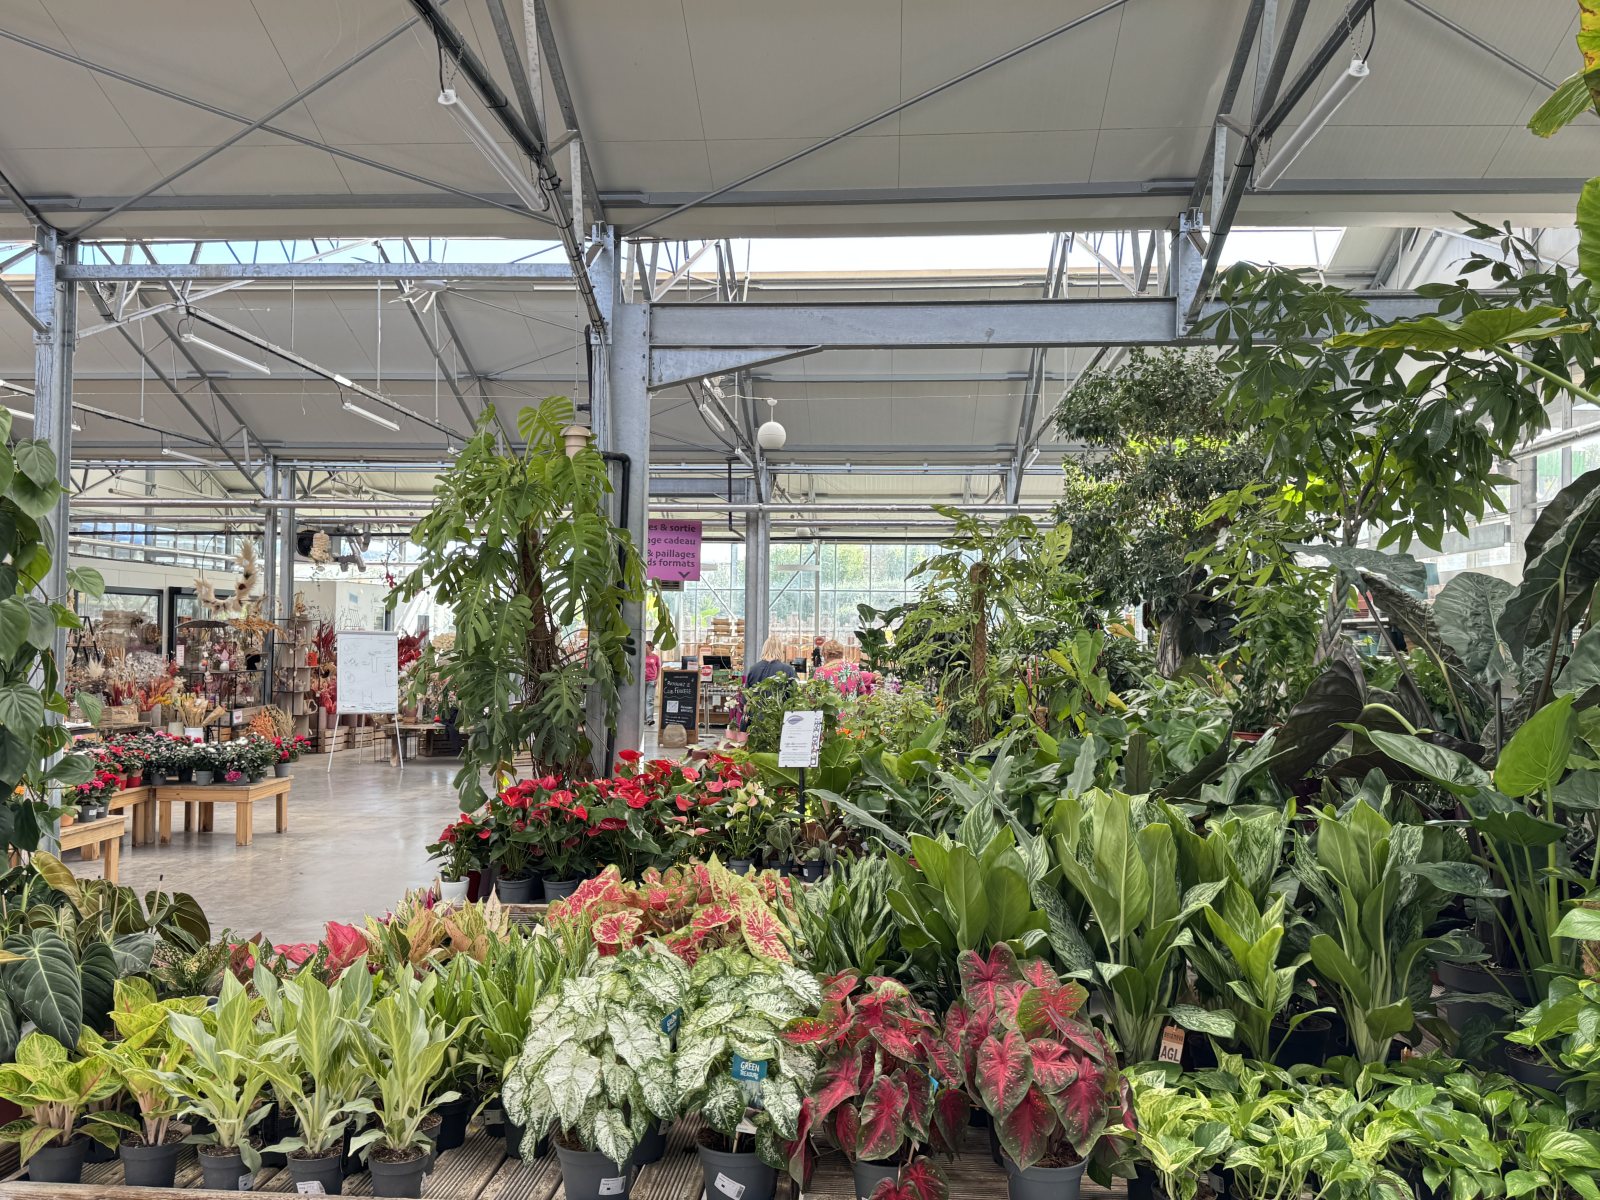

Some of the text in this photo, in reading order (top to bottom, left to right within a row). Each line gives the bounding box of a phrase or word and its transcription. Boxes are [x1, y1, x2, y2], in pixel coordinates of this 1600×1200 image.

[670, 524, 696, 533] sortie
[664, 537, 696, 545] cadeau
[655, 549, 696, 560] paillages
[659, 559, 695, 567] formats
[1160, 1045, 1180, 1062] AGL
[740, 1061, 760, 1073] GREEN
